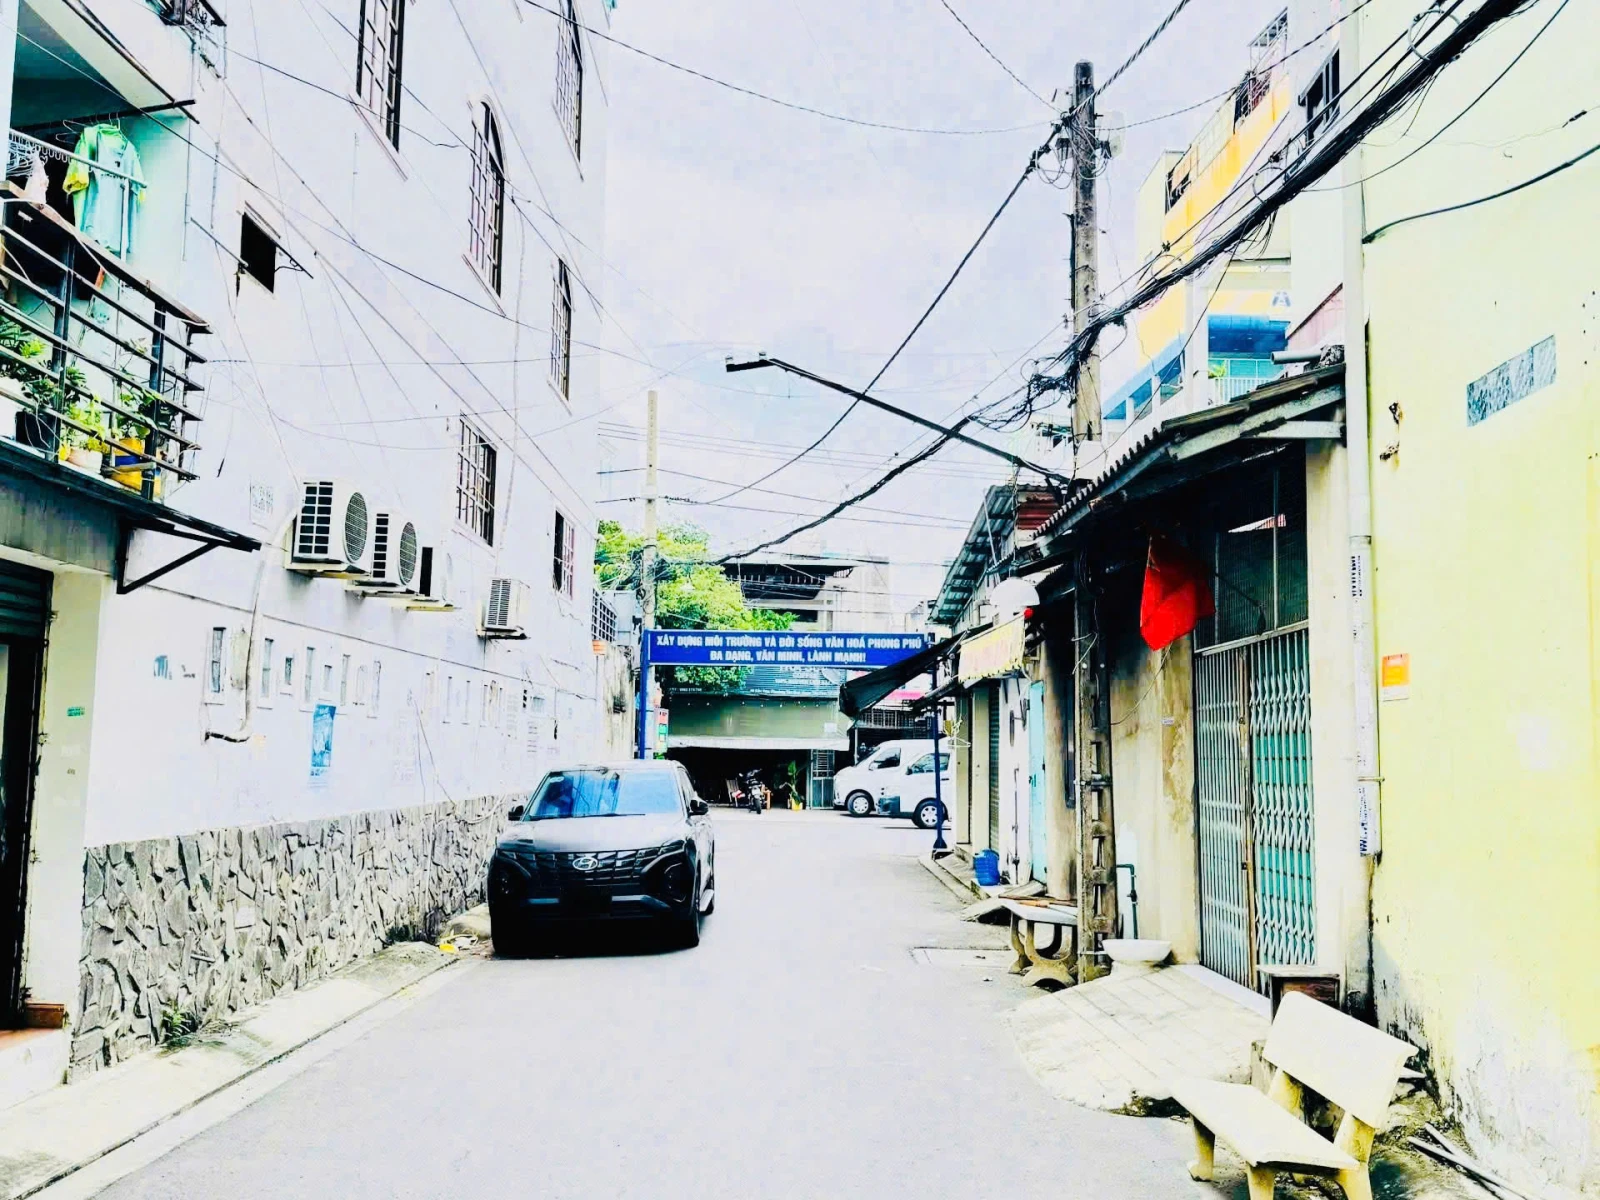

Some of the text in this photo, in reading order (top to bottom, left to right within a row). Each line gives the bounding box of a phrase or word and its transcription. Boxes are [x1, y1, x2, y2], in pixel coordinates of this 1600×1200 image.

[656, 634, 675, 646] XÂY
[677, 635, 703, 648] DỰNG
[704, 634, 723, 647] MÔI
[725, 634, 762, 647] TRƯỜNG
[764, 635, 777, 648] VÀ
[797, 634, 823, 648] SỐNG
[824, 635, 845, 648] VĂN
[846, 635, 866, 649] HOÁ
[867, 638, 900, 649] PHONG
[902, 636, 922, 649] PHÚ
[755, 649, 775, 661] VĂN
[777, 651, 805, 663] MINH,
[807, 649, 832, 662] LÀNH
